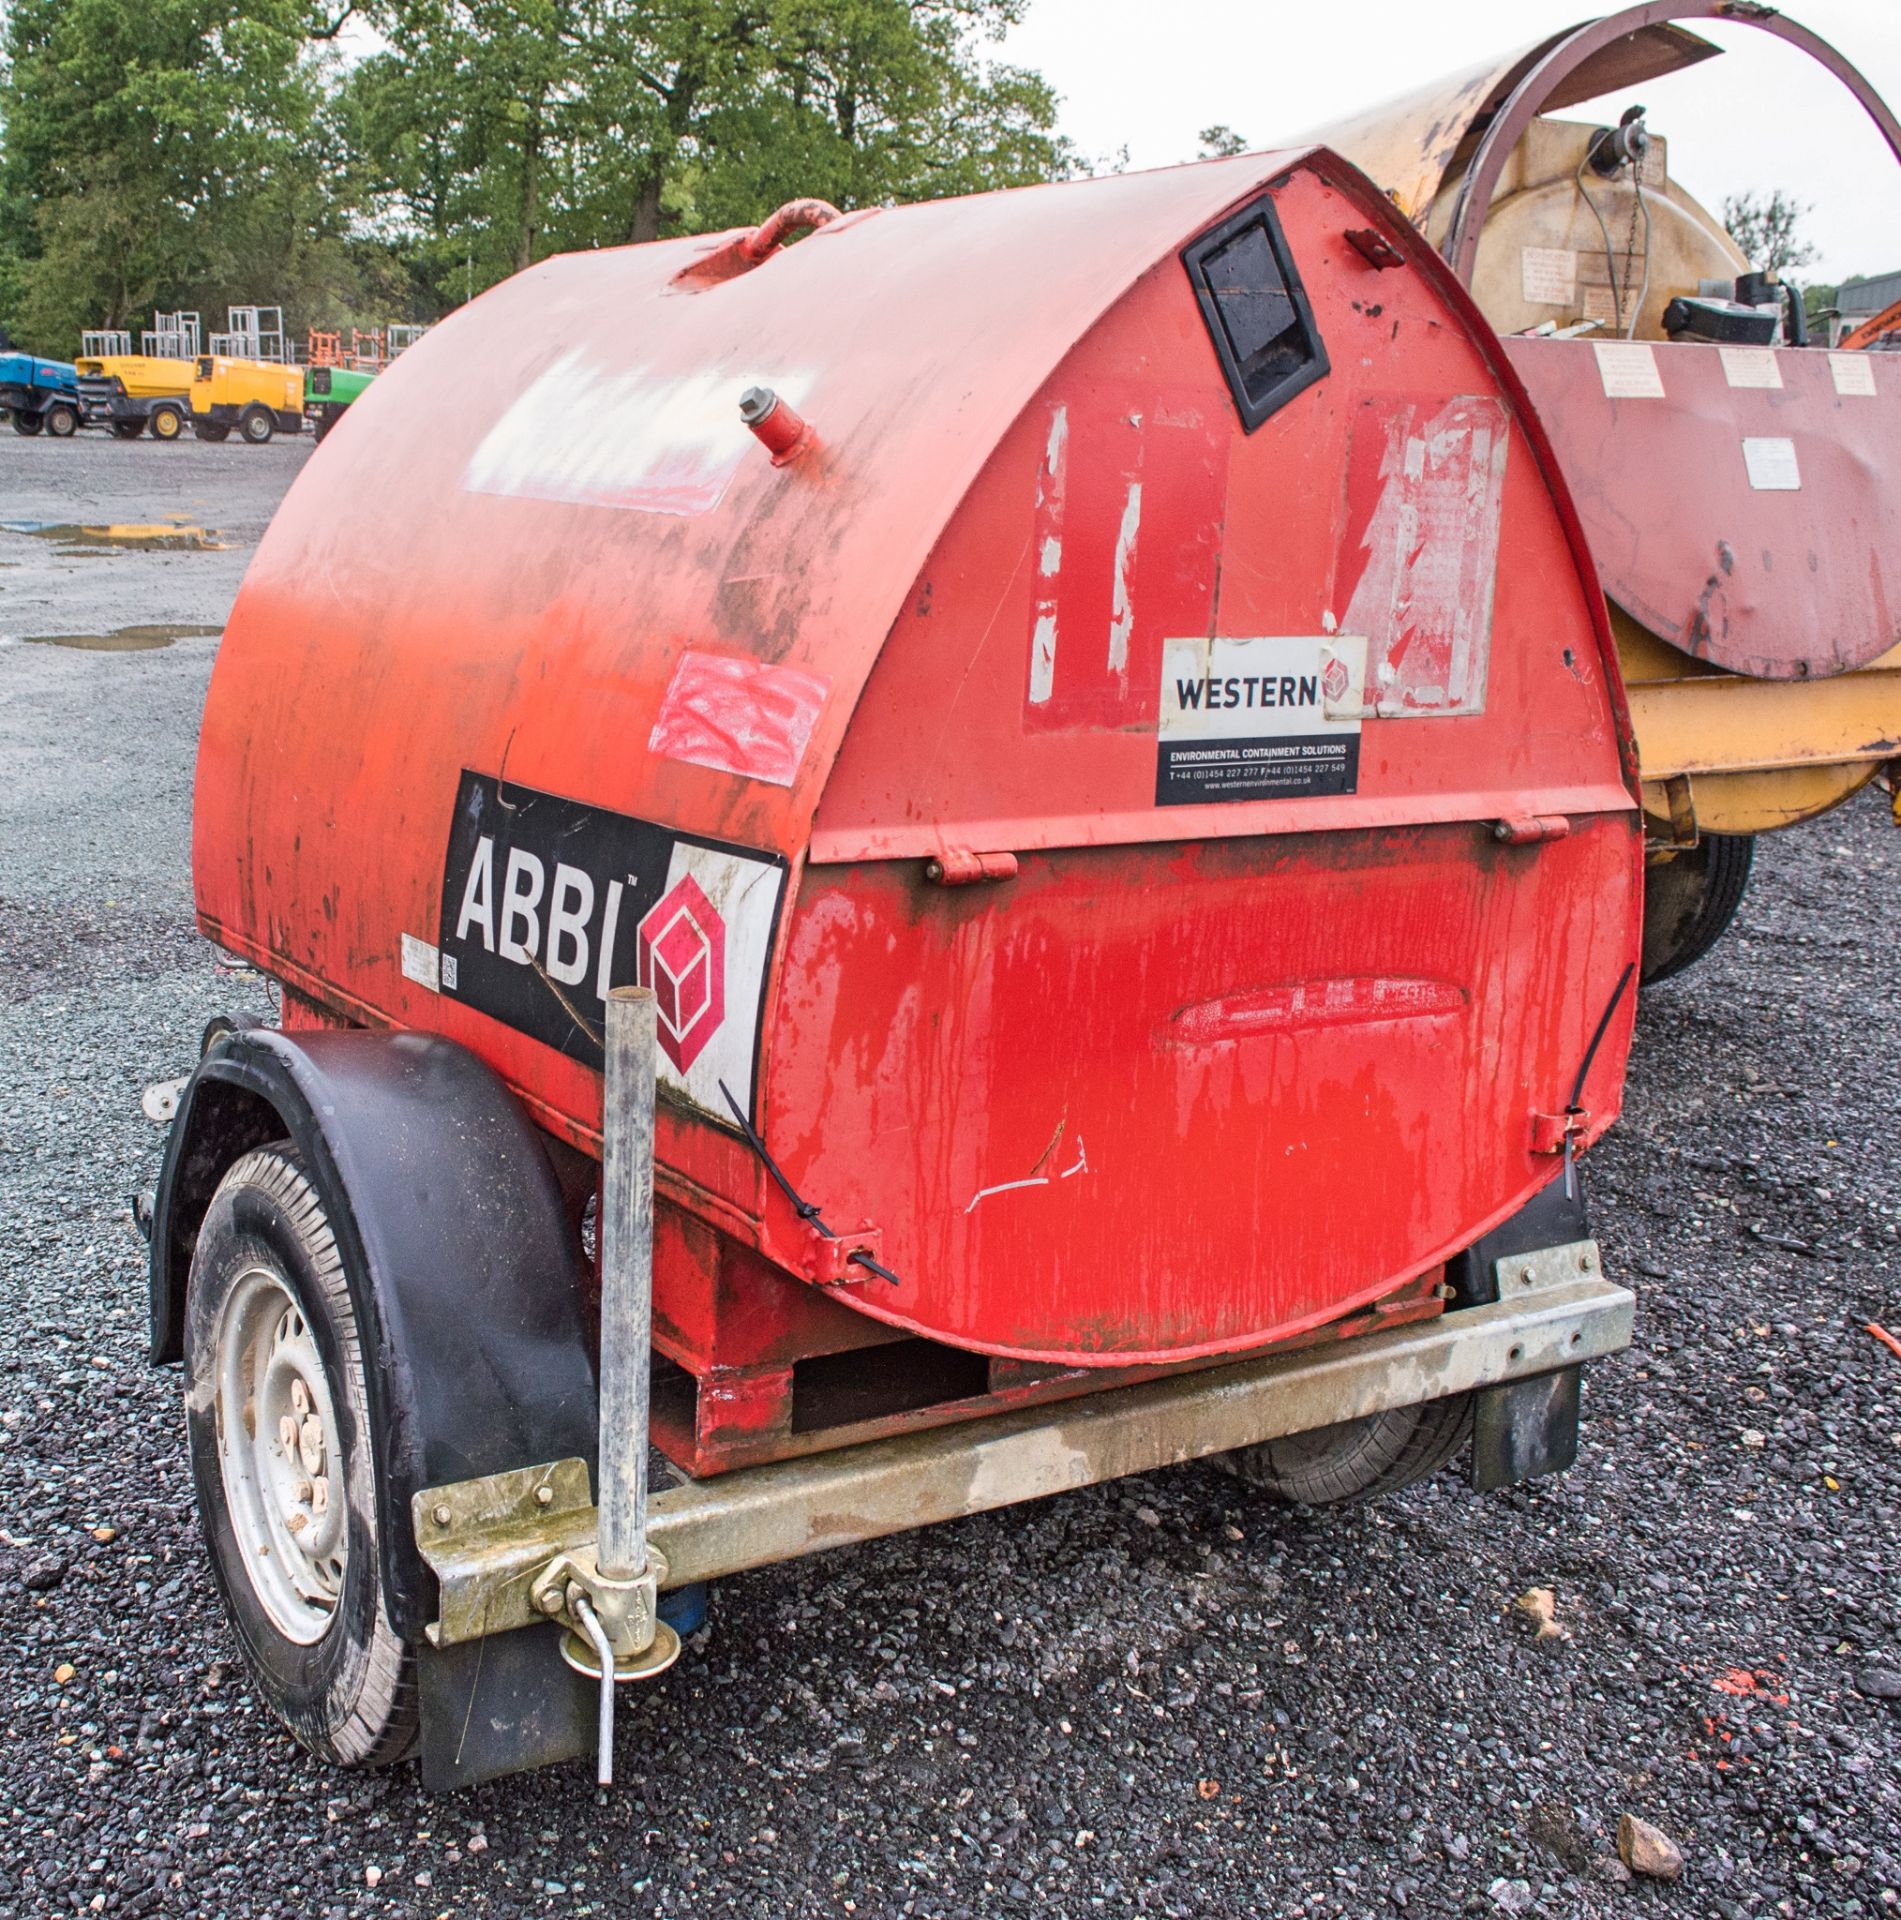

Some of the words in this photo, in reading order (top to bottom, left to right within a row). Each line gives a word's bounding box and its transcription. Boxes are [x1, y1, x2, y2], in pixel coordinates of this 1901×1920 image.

[1176, 676, 1317, 710] WESTERN
[1170, 749, 1240, 762] ENVIRONMENTAL
[1242, 746, 1300, 759] CONTAINMENT
[1302, 744, 1346, 756] SOLUTIONS
[1226, 768, 1241, 778] 227
[1243, 767, 1258, 777] 277
[1315, 764, 1329, 773] 227
[1331, 763, 1345, 772] 549
[1205, 777, 1311, 790] www.westernenvironmental.co.uk
[455, 836, 624, 1001] ABBI
